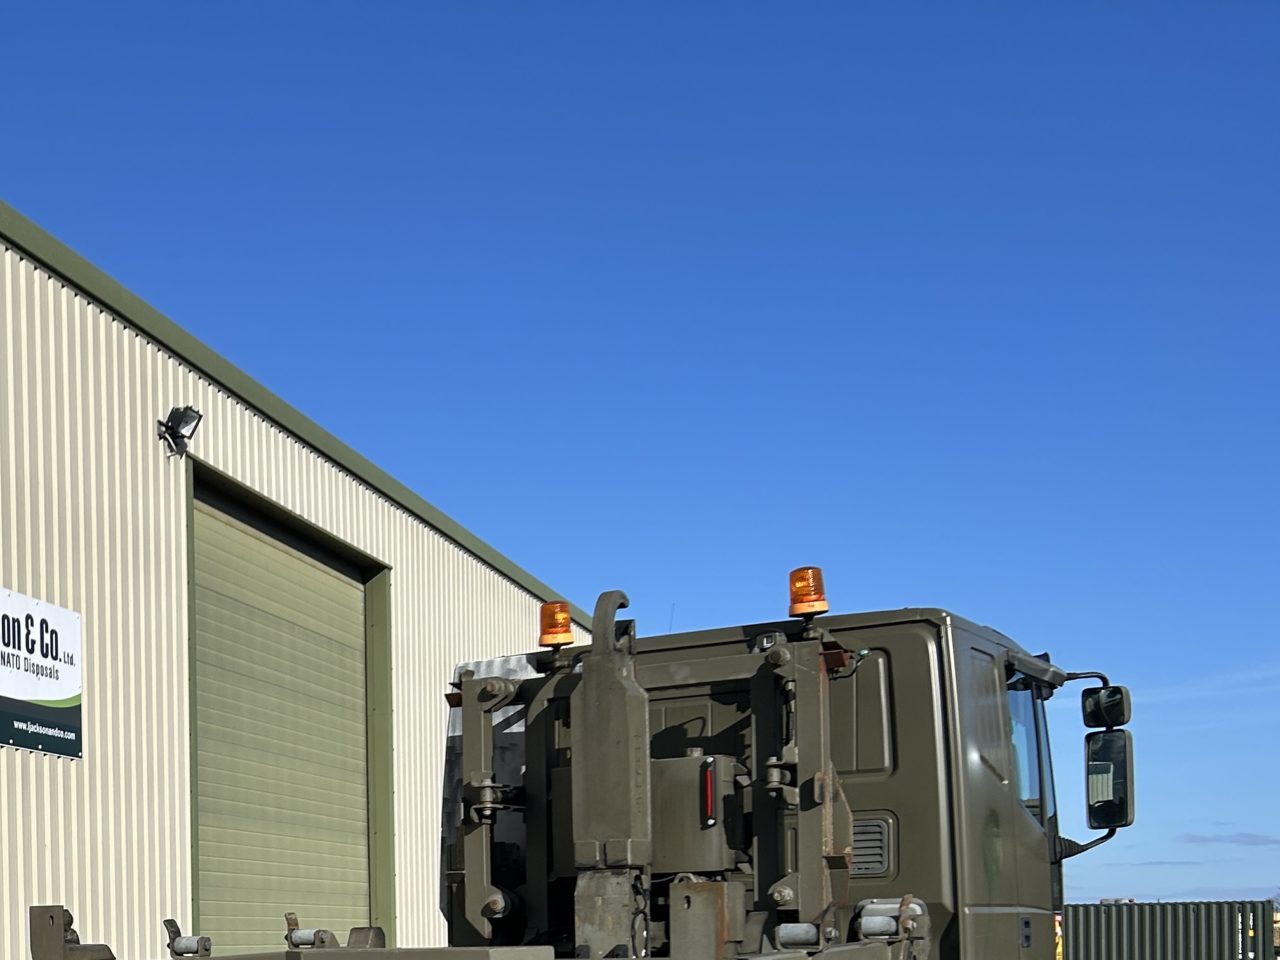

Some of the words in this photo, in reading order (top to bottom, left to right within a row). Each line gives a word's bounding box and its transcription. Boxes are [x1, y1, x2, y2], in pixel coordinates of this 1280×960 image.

[25, 613, 36, 655] &
[40, 617, 62, 662] Co.
[64, 651, 76, 667] Ltd.
[24, 657, 59, 680] Disposals
